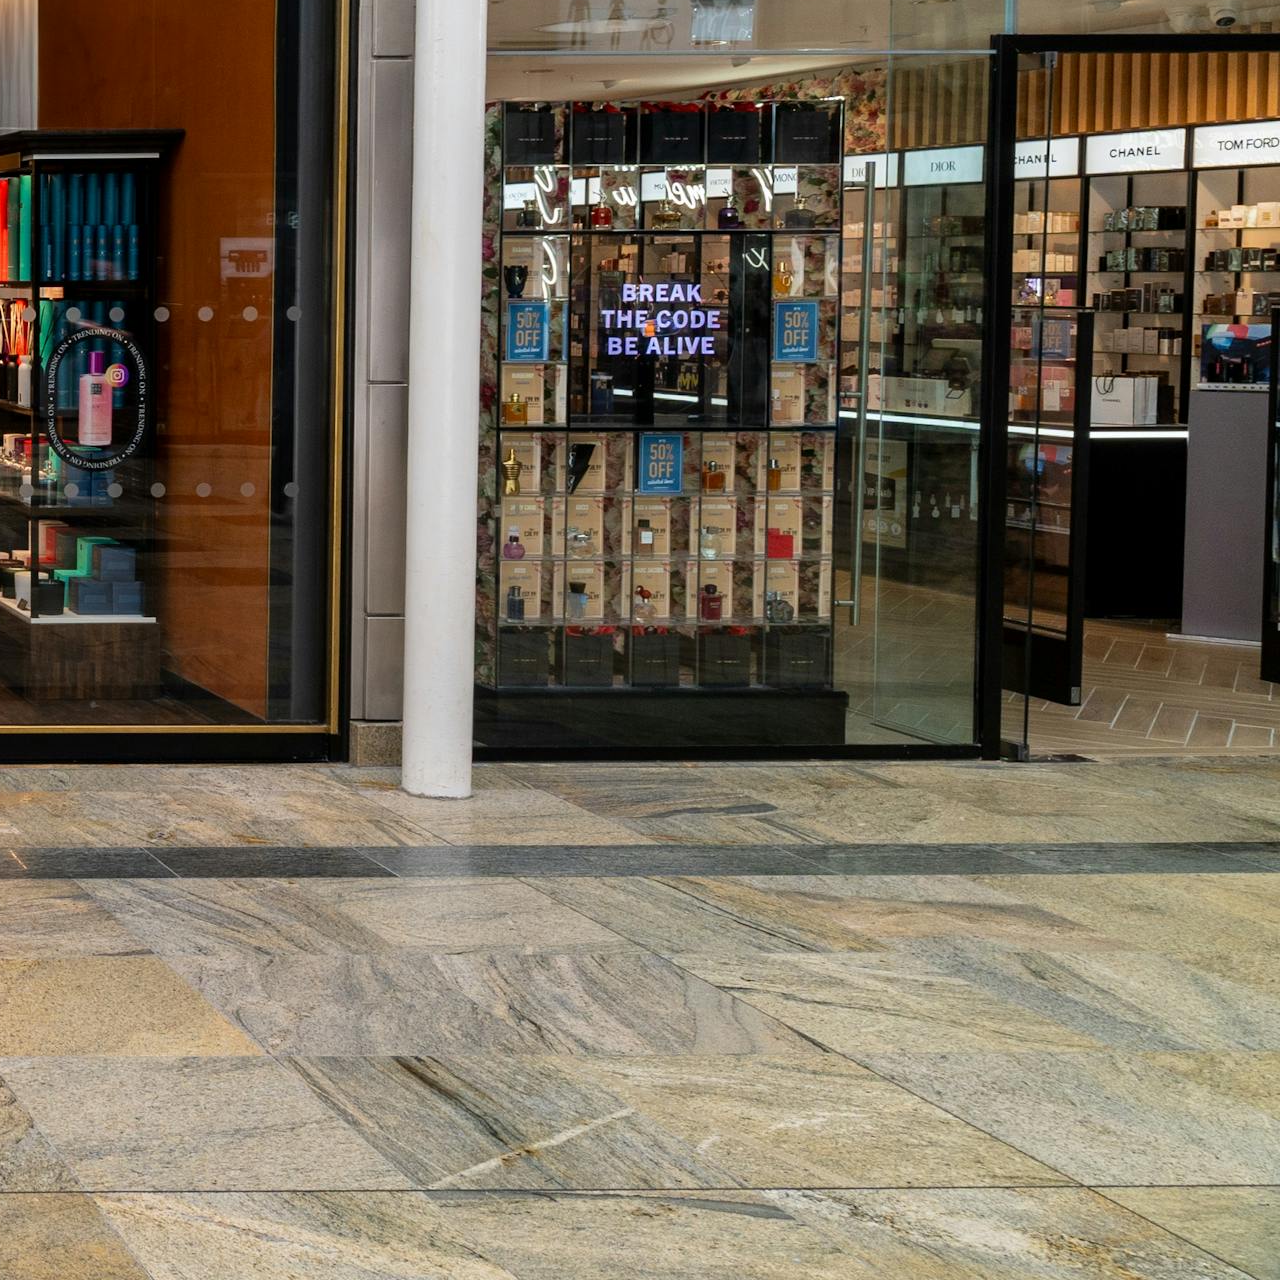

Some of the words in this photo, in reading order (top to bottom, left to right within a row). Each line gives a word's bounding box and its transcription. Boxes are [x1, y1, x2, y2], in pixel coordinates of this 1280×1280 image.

[1109, 146, 1161, 158] CHANEL
[1217, 139, 1244, 152] TOM
[1246, 137, 1280, 149] FORD
[851, 167, 866, 178] DIO
[930, 161, 956, 172] DIOR
[623, 284, 702, 302] BREAK
[516, 312, 540, 329] 50%
[601, 310, 648, 328] THE
[656, 310, 721, 329] CODE
[784, 312, 809, 328] 50%
[71, 328, 111, 341] TRENDING
[112, 332, 125, 341] ON
[515, 330, 540, 346] OFF
[783, 330, 809, 346] OFF
[608, 337, 639, 355] BE
[646, 337, 715, 355] ALIVE
[48, 353, 61, 395] TRENDING
[58, 342, 69, 354] ON
[128, 342, 146, 381] TRENDING
[140, 381, 146, 395] ON
[48, 402, 55, 417] ON
[135, 403, 146, 445] TRENDING
[48, 418, 66, 456] TRENDING
[125, 444, 136, 455] ON
[649, 444, 674, 461] 50%
[70, 456, 82, 466] ON
[83, 456, 122, 469] TRENDING
[648, 462, 674, 478] OFF
